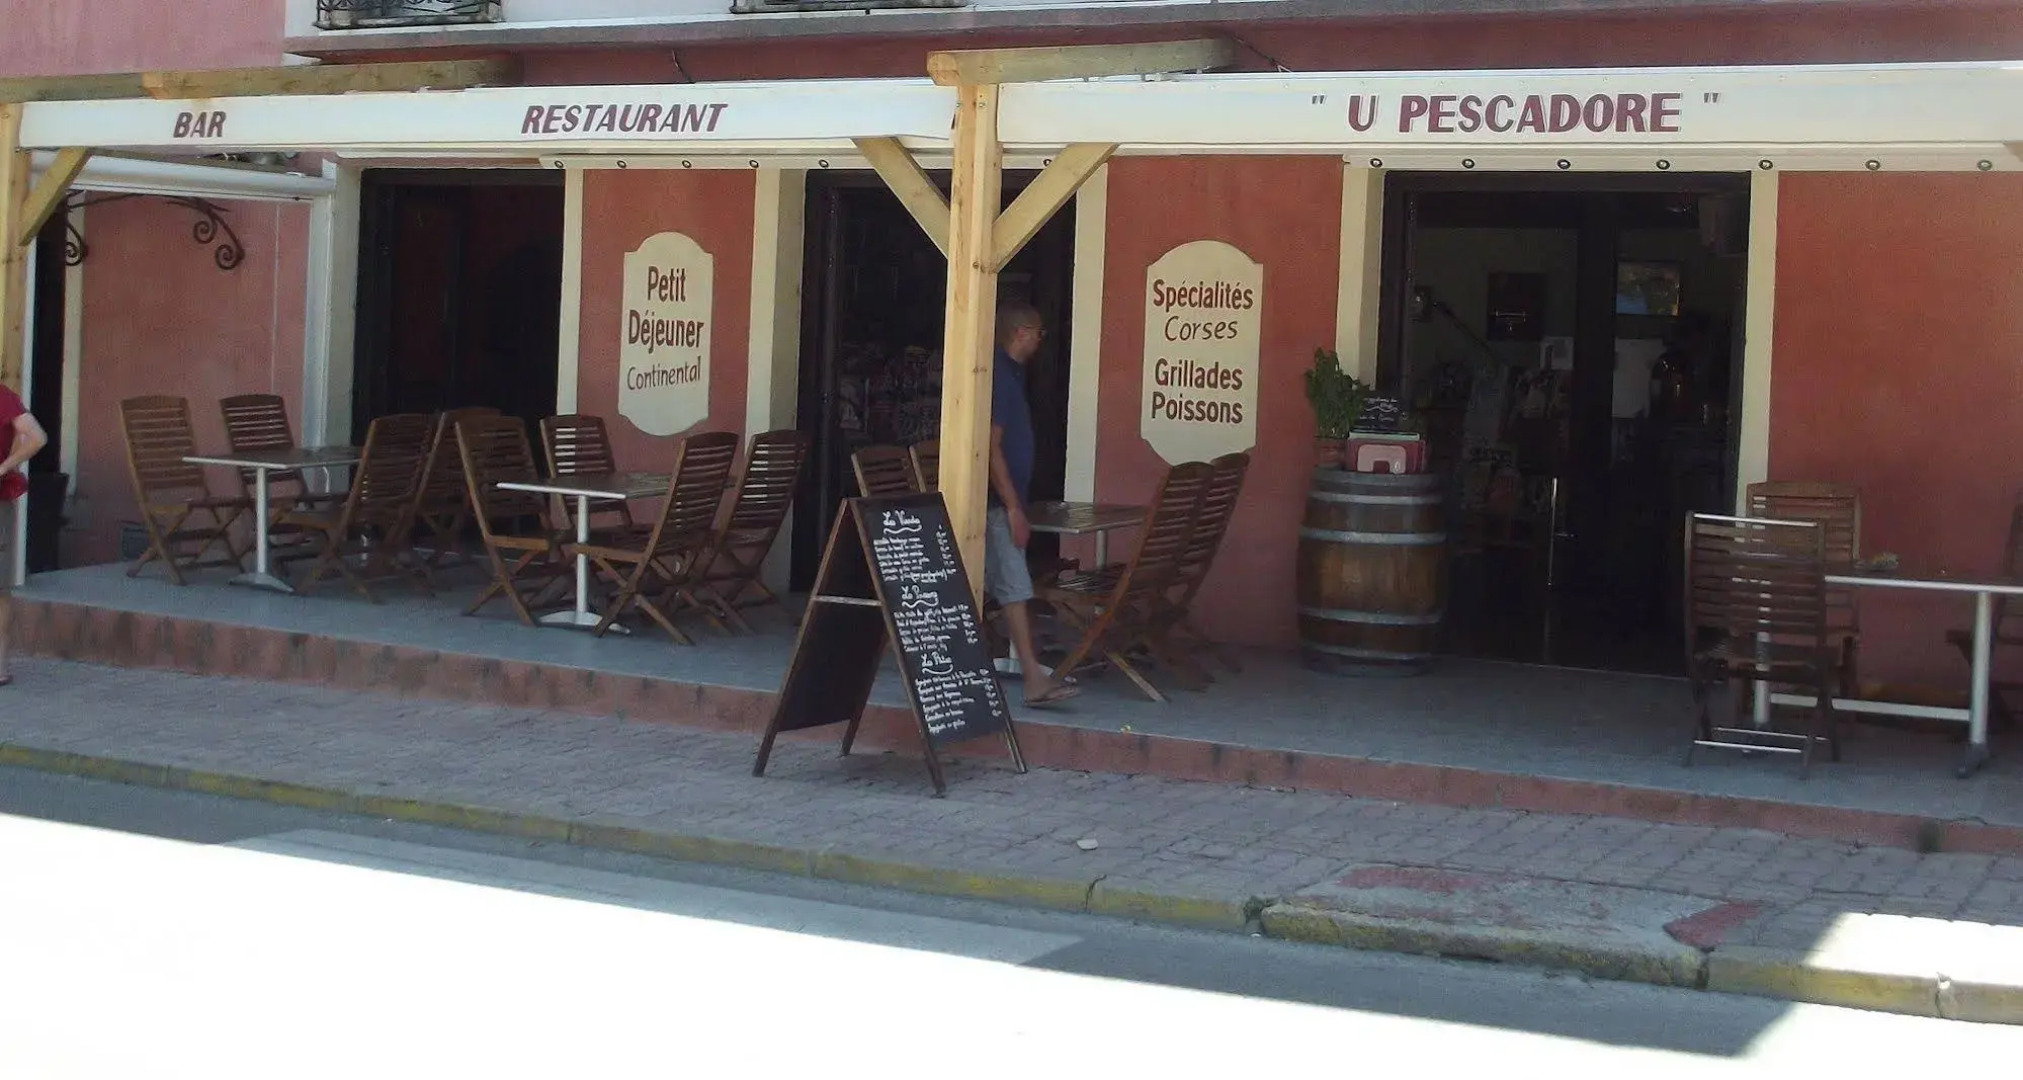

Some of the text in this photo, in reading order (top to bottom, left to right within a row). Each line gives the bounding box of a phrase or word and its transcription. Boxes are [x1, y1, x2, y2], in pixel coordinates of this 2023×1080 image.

[173, 110, 227, 138] BAR
[521, 103, 728, 134] RESTAURANT
[1348, 94, 1379, 133] U
[1398, 92, 1682, 133] PESCADORE
[647, 265, 686, 302] Petit
[1153, 278, 1254, 313] Spécialités
[628, 309, 705, 354] Déjeuner
[1164, 315, 1239, 342] Corses
[626, 355, 702, 391] Continental
[1155, 357, 1243, 390] Grillades
[1151, 391, 1244, 424] Poissons
